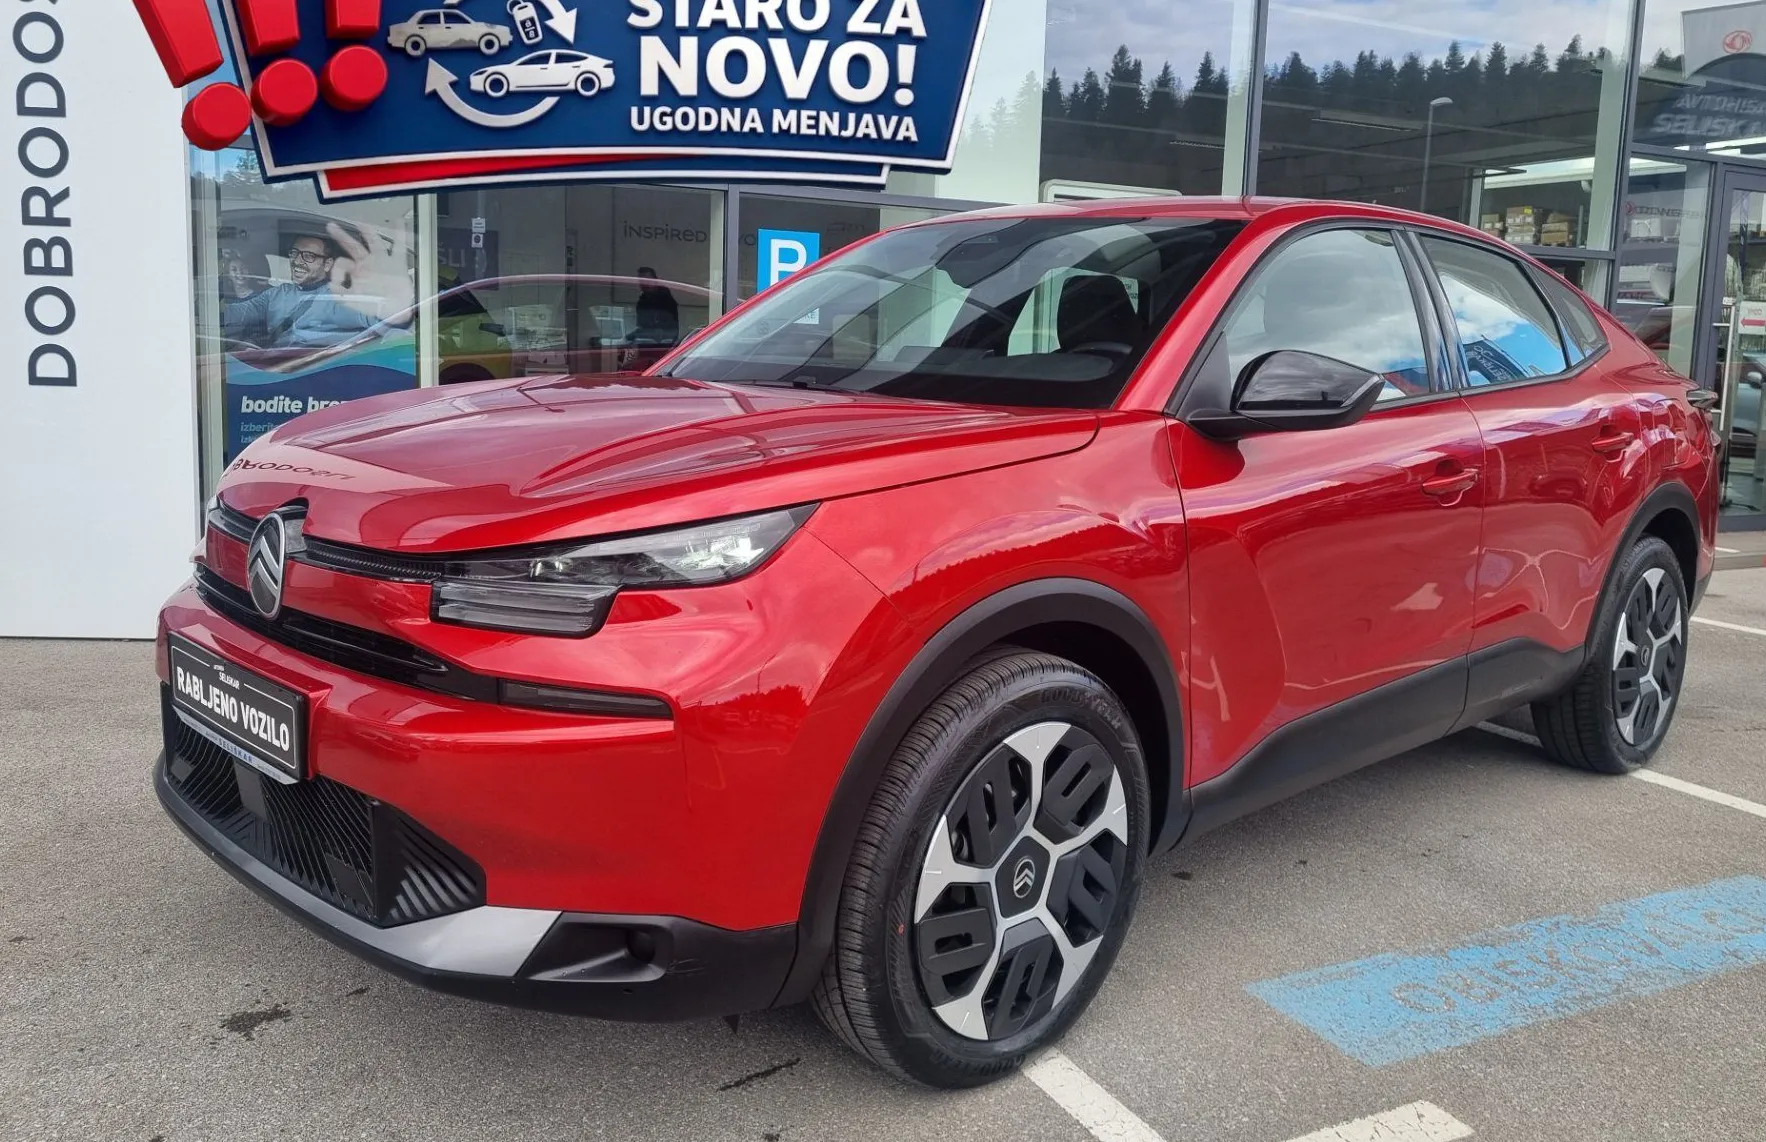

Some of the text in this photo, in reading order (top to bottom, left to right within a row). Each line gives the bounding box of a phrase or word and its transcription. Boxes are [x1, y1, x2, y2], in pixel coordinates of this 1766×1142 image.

[12, 0, 77, 387] DOBRODO
[770, 238, 807, 286] P
[241, 395, 303, 414] bodite
[177, 666, 289, 752] RABLJENO VOZILO
